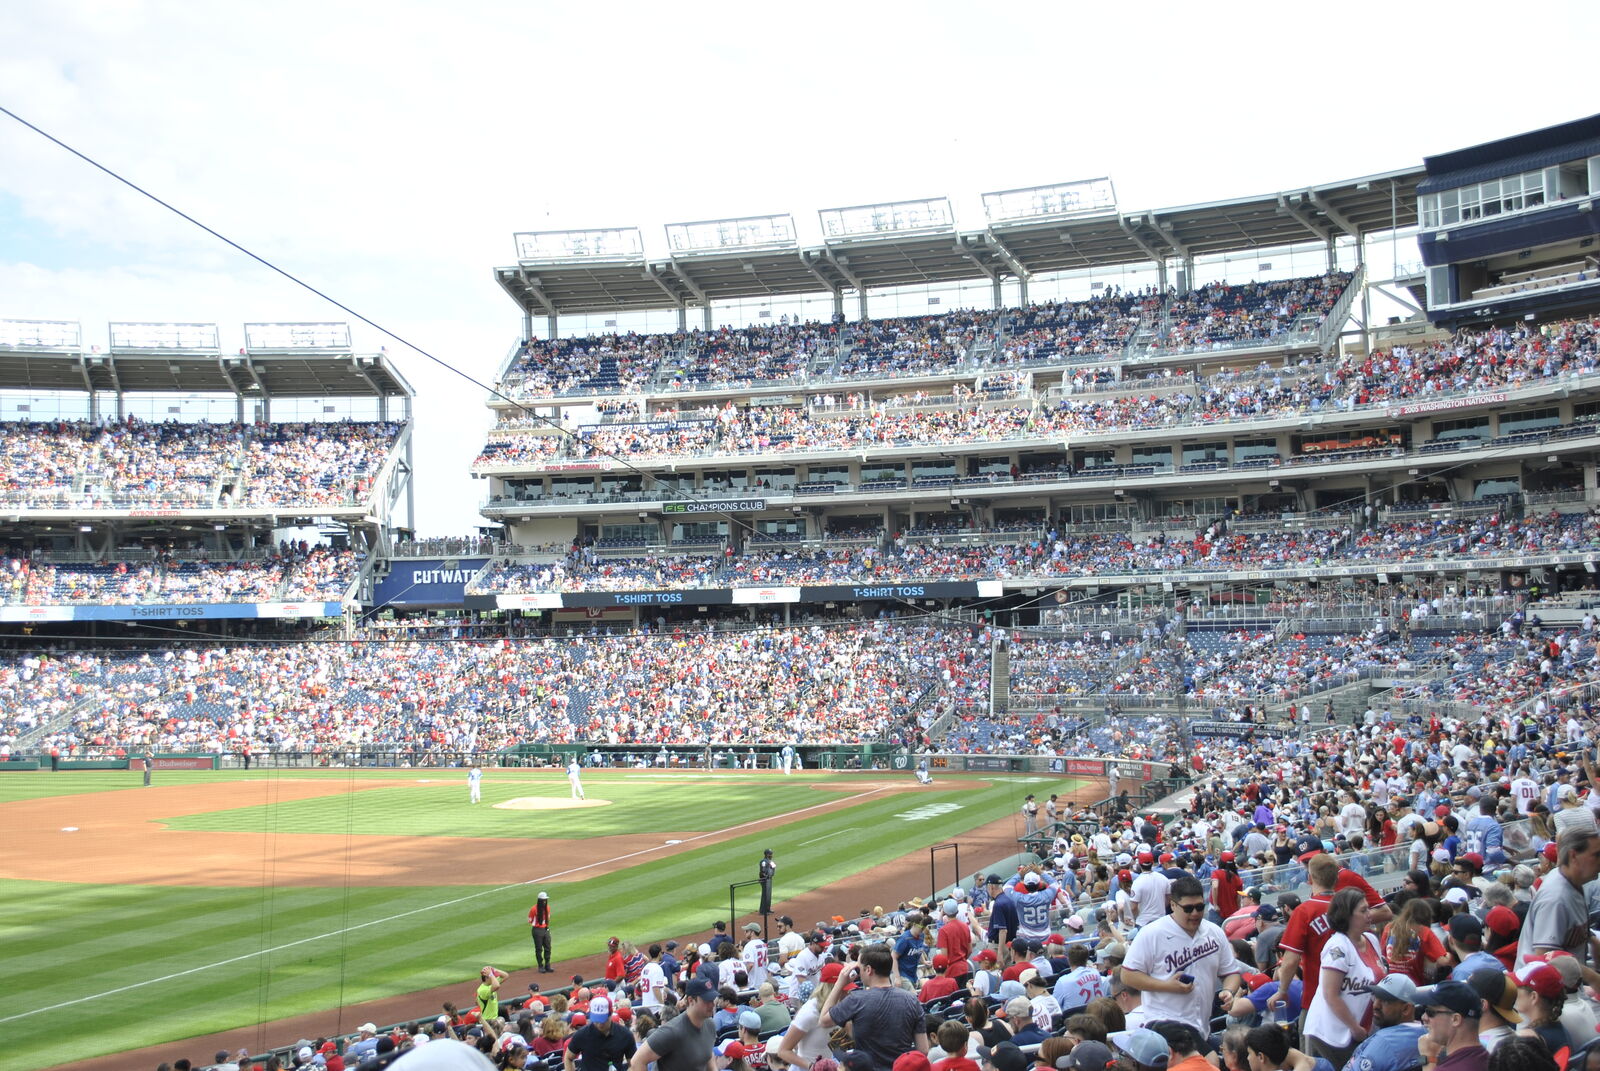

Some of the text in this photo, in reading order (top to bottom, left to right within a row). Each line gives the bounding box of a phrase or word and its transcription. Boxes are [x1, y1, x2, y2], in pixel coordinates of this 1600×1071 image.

[1420, 400, 1465, 412] WASHINGTON
[1466, 394, 1504, 406] NATIONALS
[688, 502, 738, 512] CHAMPIONS
[740, 501, 762, 510] CLUB
[854, 586, 924, 597] T-SHIRT TOSS
[615, 594, 682, 604] T-SHIRT TOSS
[132, 608, 204, 616] T-SHIRT TOSS
[1522, 788, 1534, 798] 01
[1024, 906, 1047, 924] 26
[1164, 937, 1219, 973] Nationals
